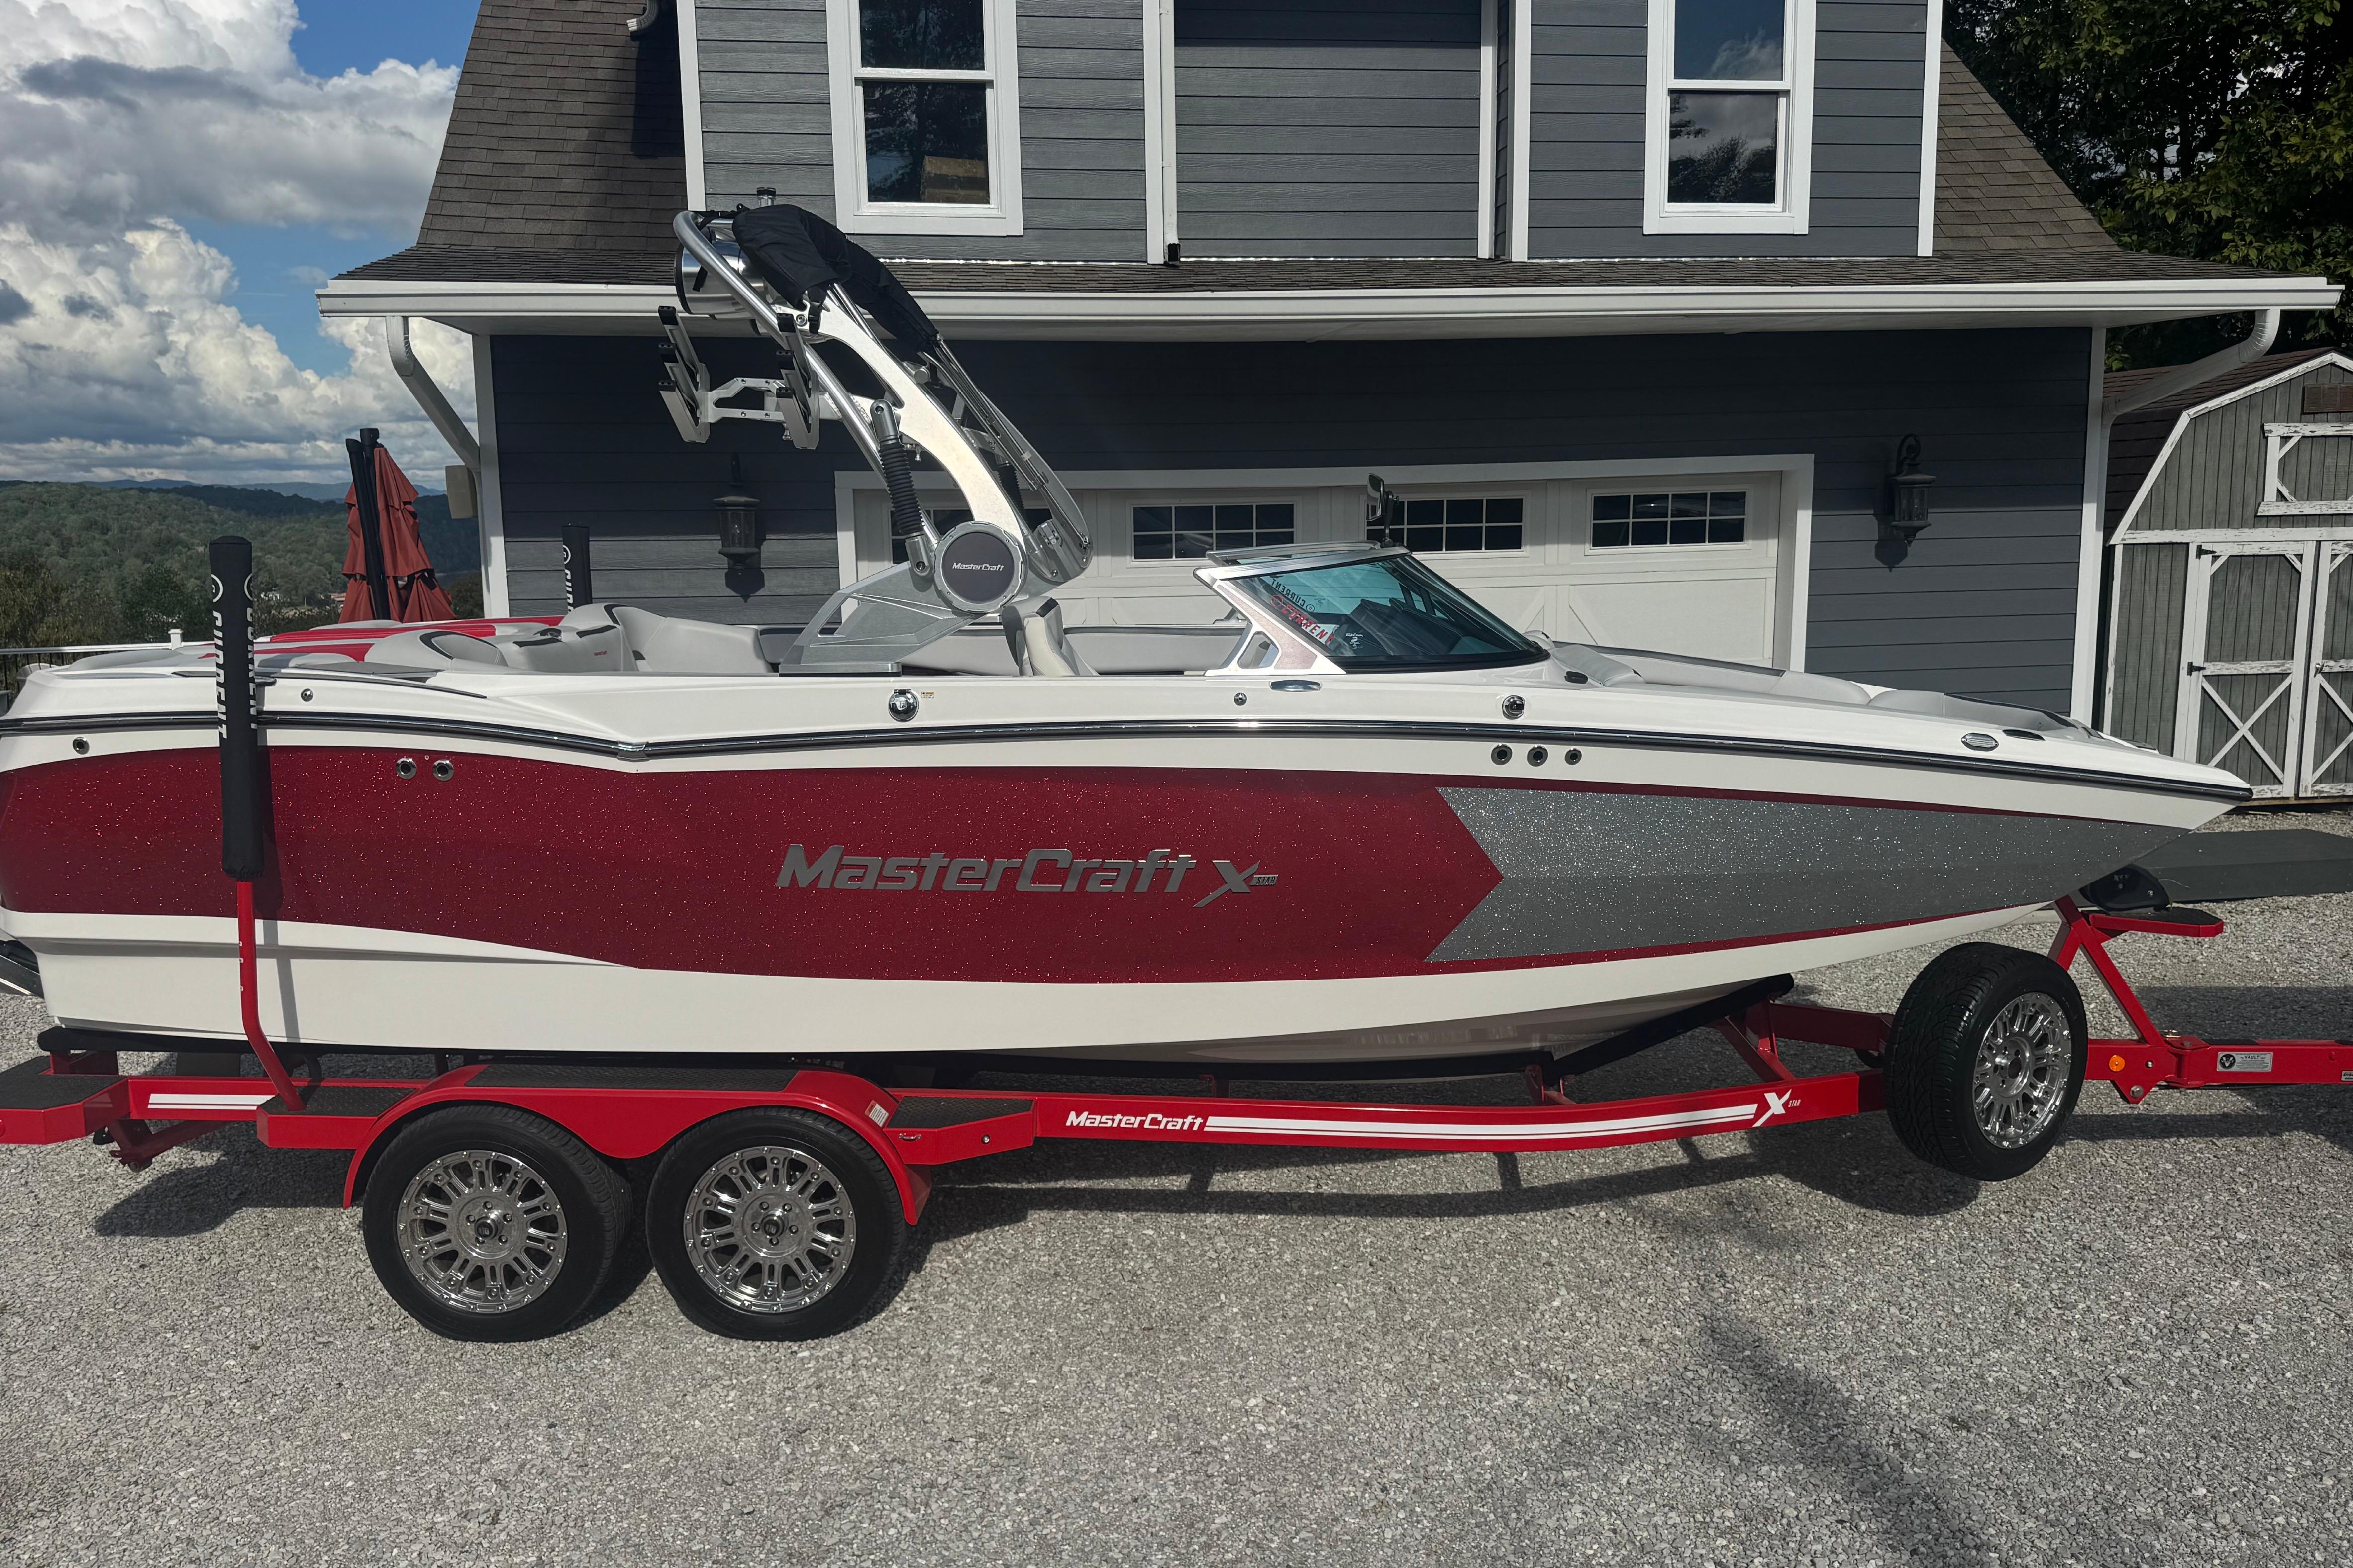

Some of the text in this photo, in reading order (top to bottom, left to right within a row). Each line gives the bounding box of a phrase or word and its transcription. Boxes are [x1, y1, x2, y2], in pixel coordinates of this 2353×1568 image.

[952, 562, 1004, 571] MasterCraft
[776, 844, 1276, 908] MasterCraft X STAR
[1066, 1111, 1203, 1131] MasterCraft
[1752, 1088, 1792, 1128] X
